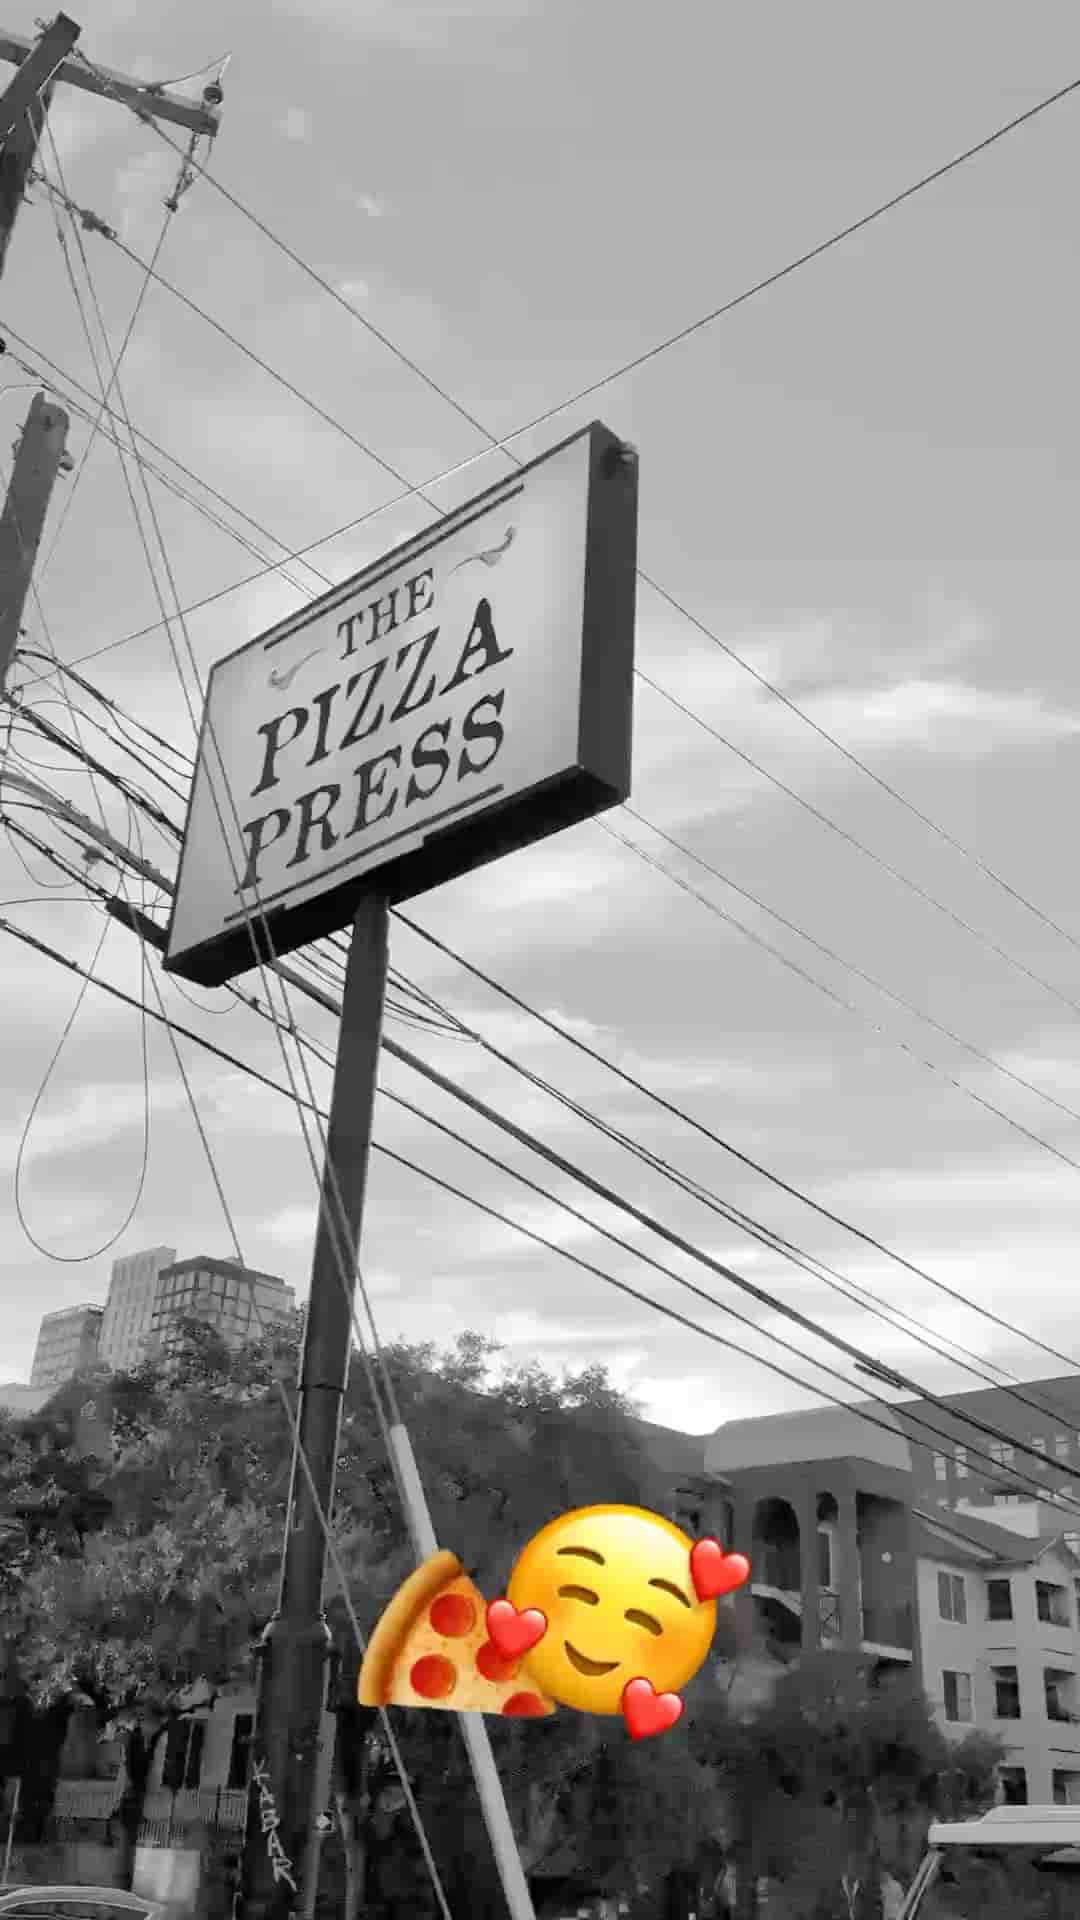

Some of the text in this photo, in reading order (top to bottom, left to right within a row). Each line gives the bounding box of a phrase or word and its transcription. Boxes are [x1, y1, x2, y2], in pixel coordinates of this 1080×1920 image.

[251, 598, 514, 797] PIZZA
[337, 568, 435, 660] THE
[233, 689, 506, 895] PRESS
